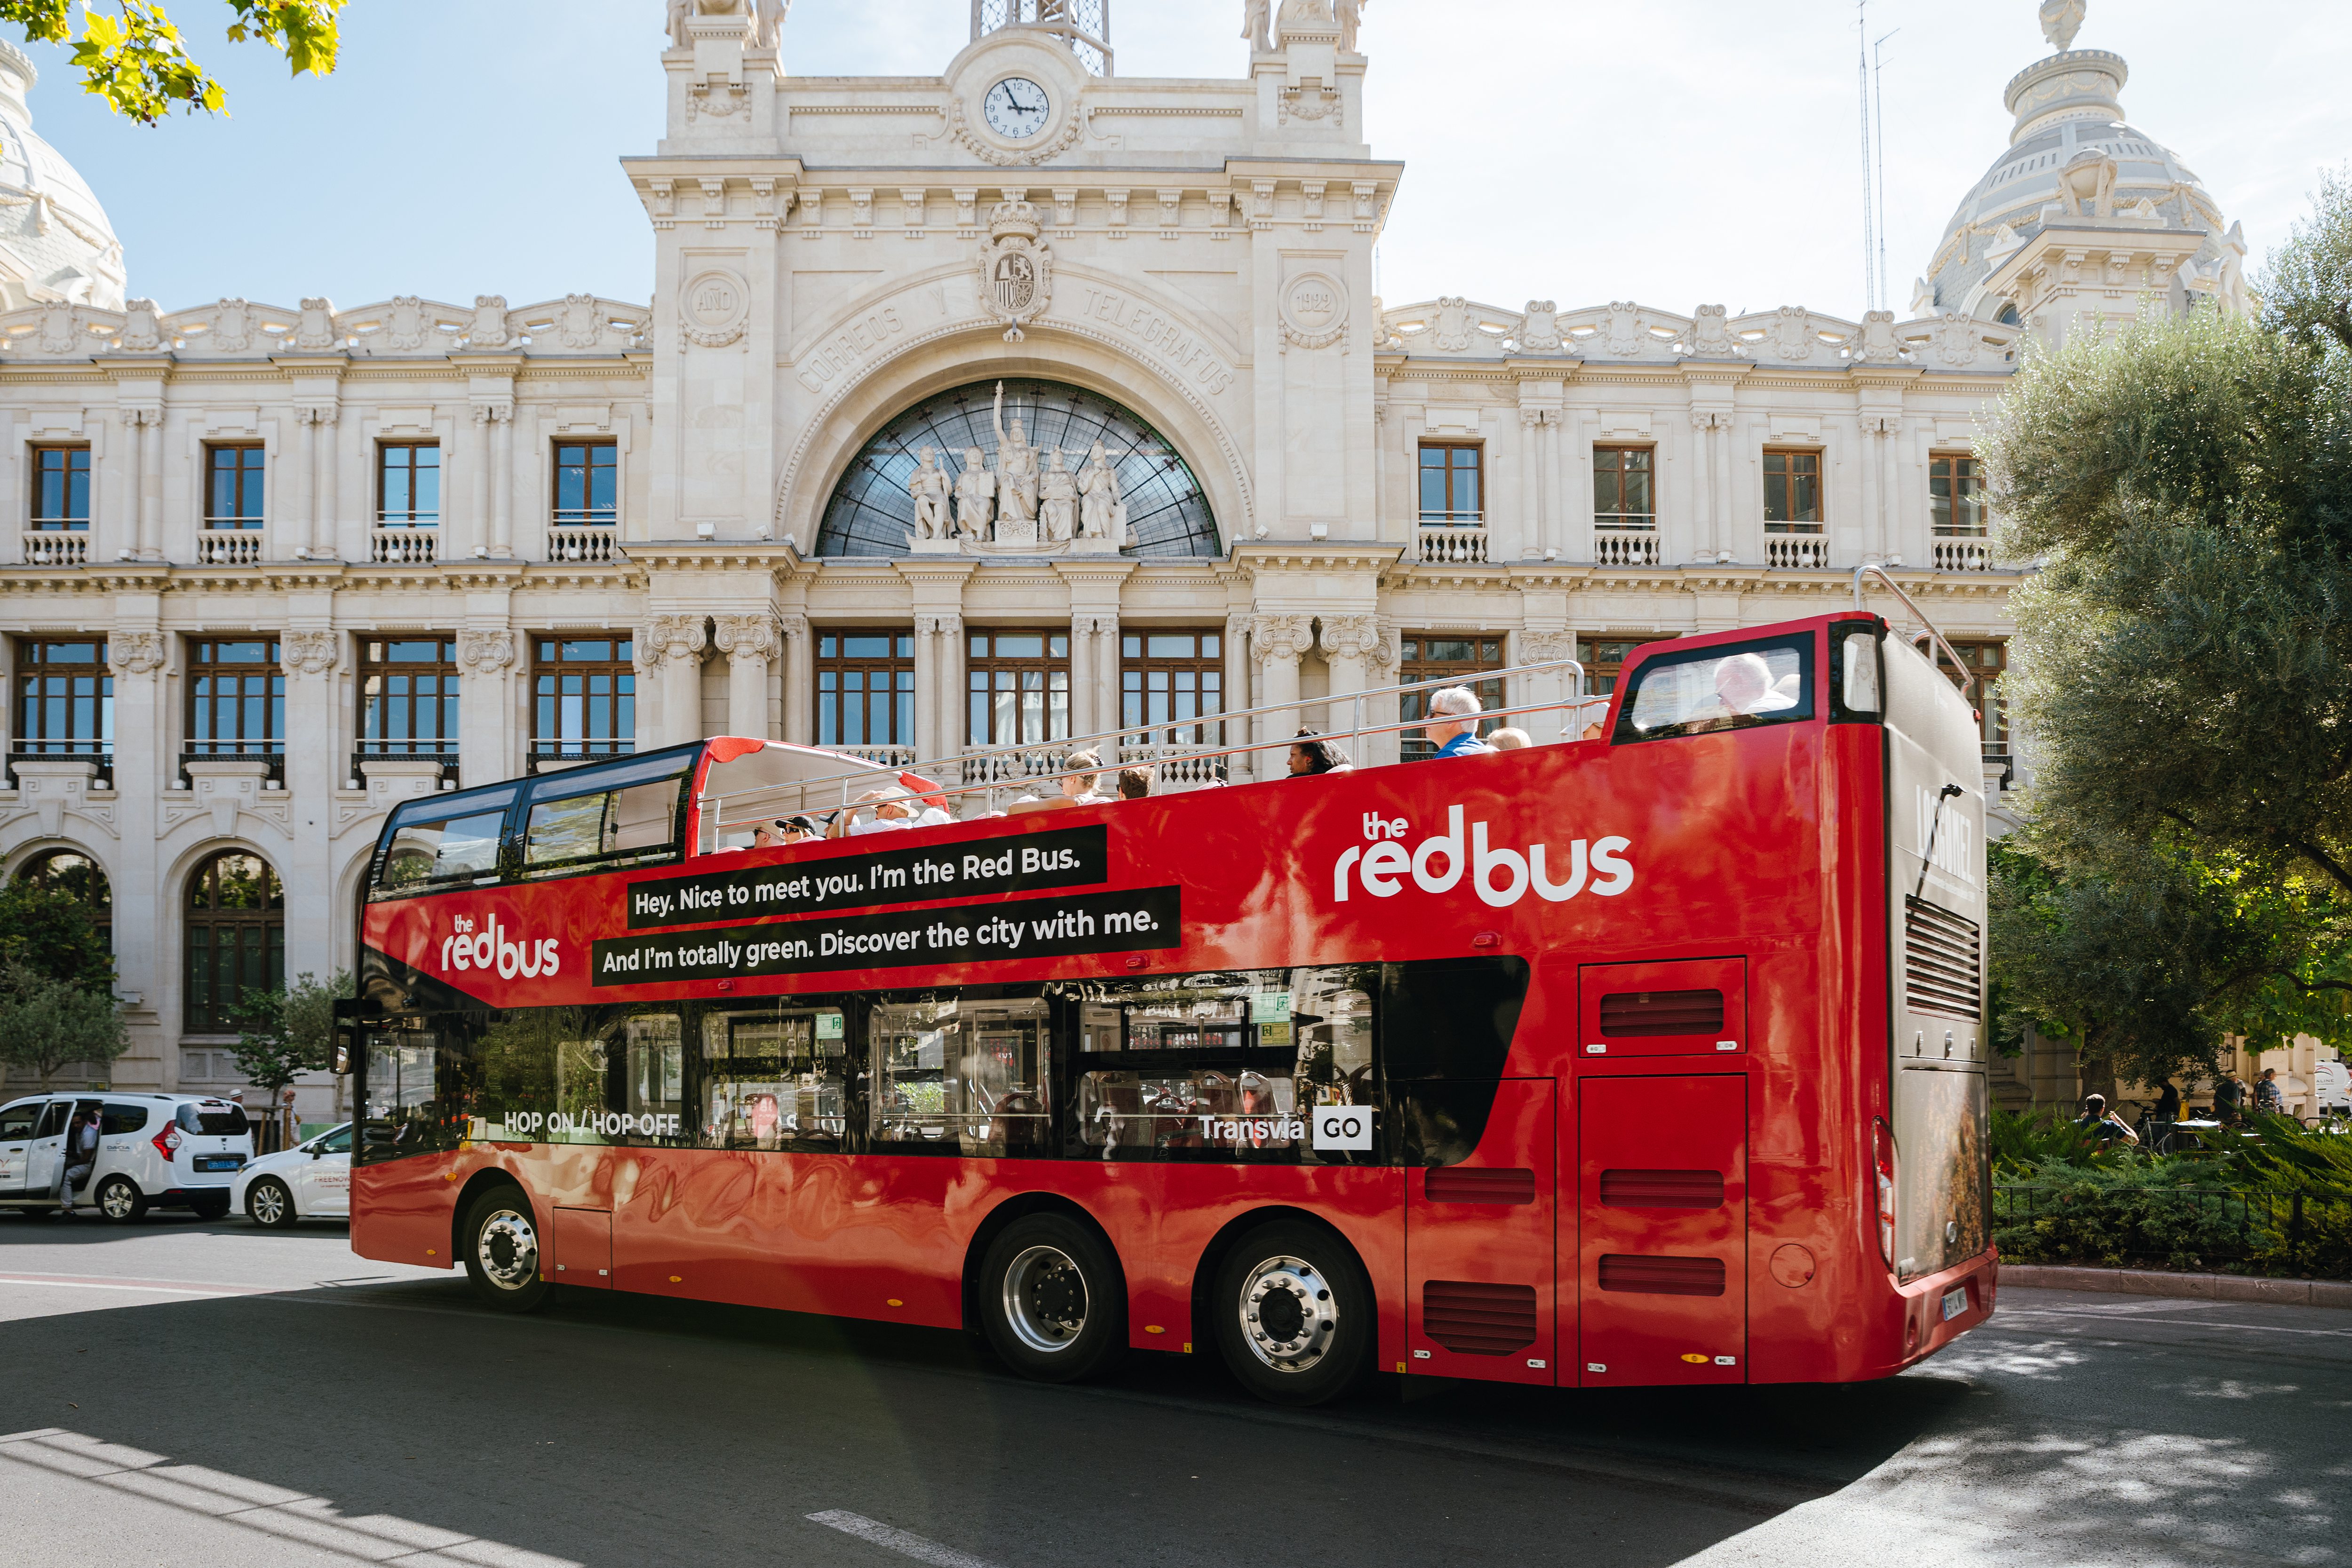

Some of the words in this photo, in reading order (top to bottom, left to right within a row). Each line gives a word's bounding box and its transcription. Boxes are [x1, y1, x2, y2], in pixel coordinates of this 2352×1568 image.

[1025, 125, 1031, 133] 5
[697, 287, 732, 311] AÑO
[1297, 293, 1331, 312] 1922
[797, 307, 903, 393] CORREOS
[929, 286, 946, 314] Y
[1083, 287, 1233, 395] TELEGRAFOS
[1363, 812, 1408, 840] the
[636, 893, 674, 918] Hey.
[681, 885, 722, 909] Nice
[728, 885, 749, 904] to
[755, 876, 810, 902] meet
[816, 875, 864, 902] you.
[871, 864, 905, 889] I'm
[913, 859, 954, 884] the
[964, 849, 1012, 879] Red
[1022, 848, 1080, 873] Bus.
[454, 914, 473, 933] the
[603, 949, 639, 972] And
[645, 947, 673, 969] I'm
[678, 941, 741, 968] totally
[747, 939, 813, 963] green.
[821, 930, 920, 955] Discover
[927, 923, 969, 947] the
[977, 916, 1025, 948] city
[1032, 910, 1094, 939] with
[1104, 910, 1158, 934] me.
[505, 1112, 542, 1132] HOP
[548, 1112, 574, 1133] ON
[592, 1113, 634, 1135] HOP
[640, 1113, 679, 1136] OFF
[1198, 1113, 1305, 1140] Transvia
[1324, 1117, 1360, 1138] GO
